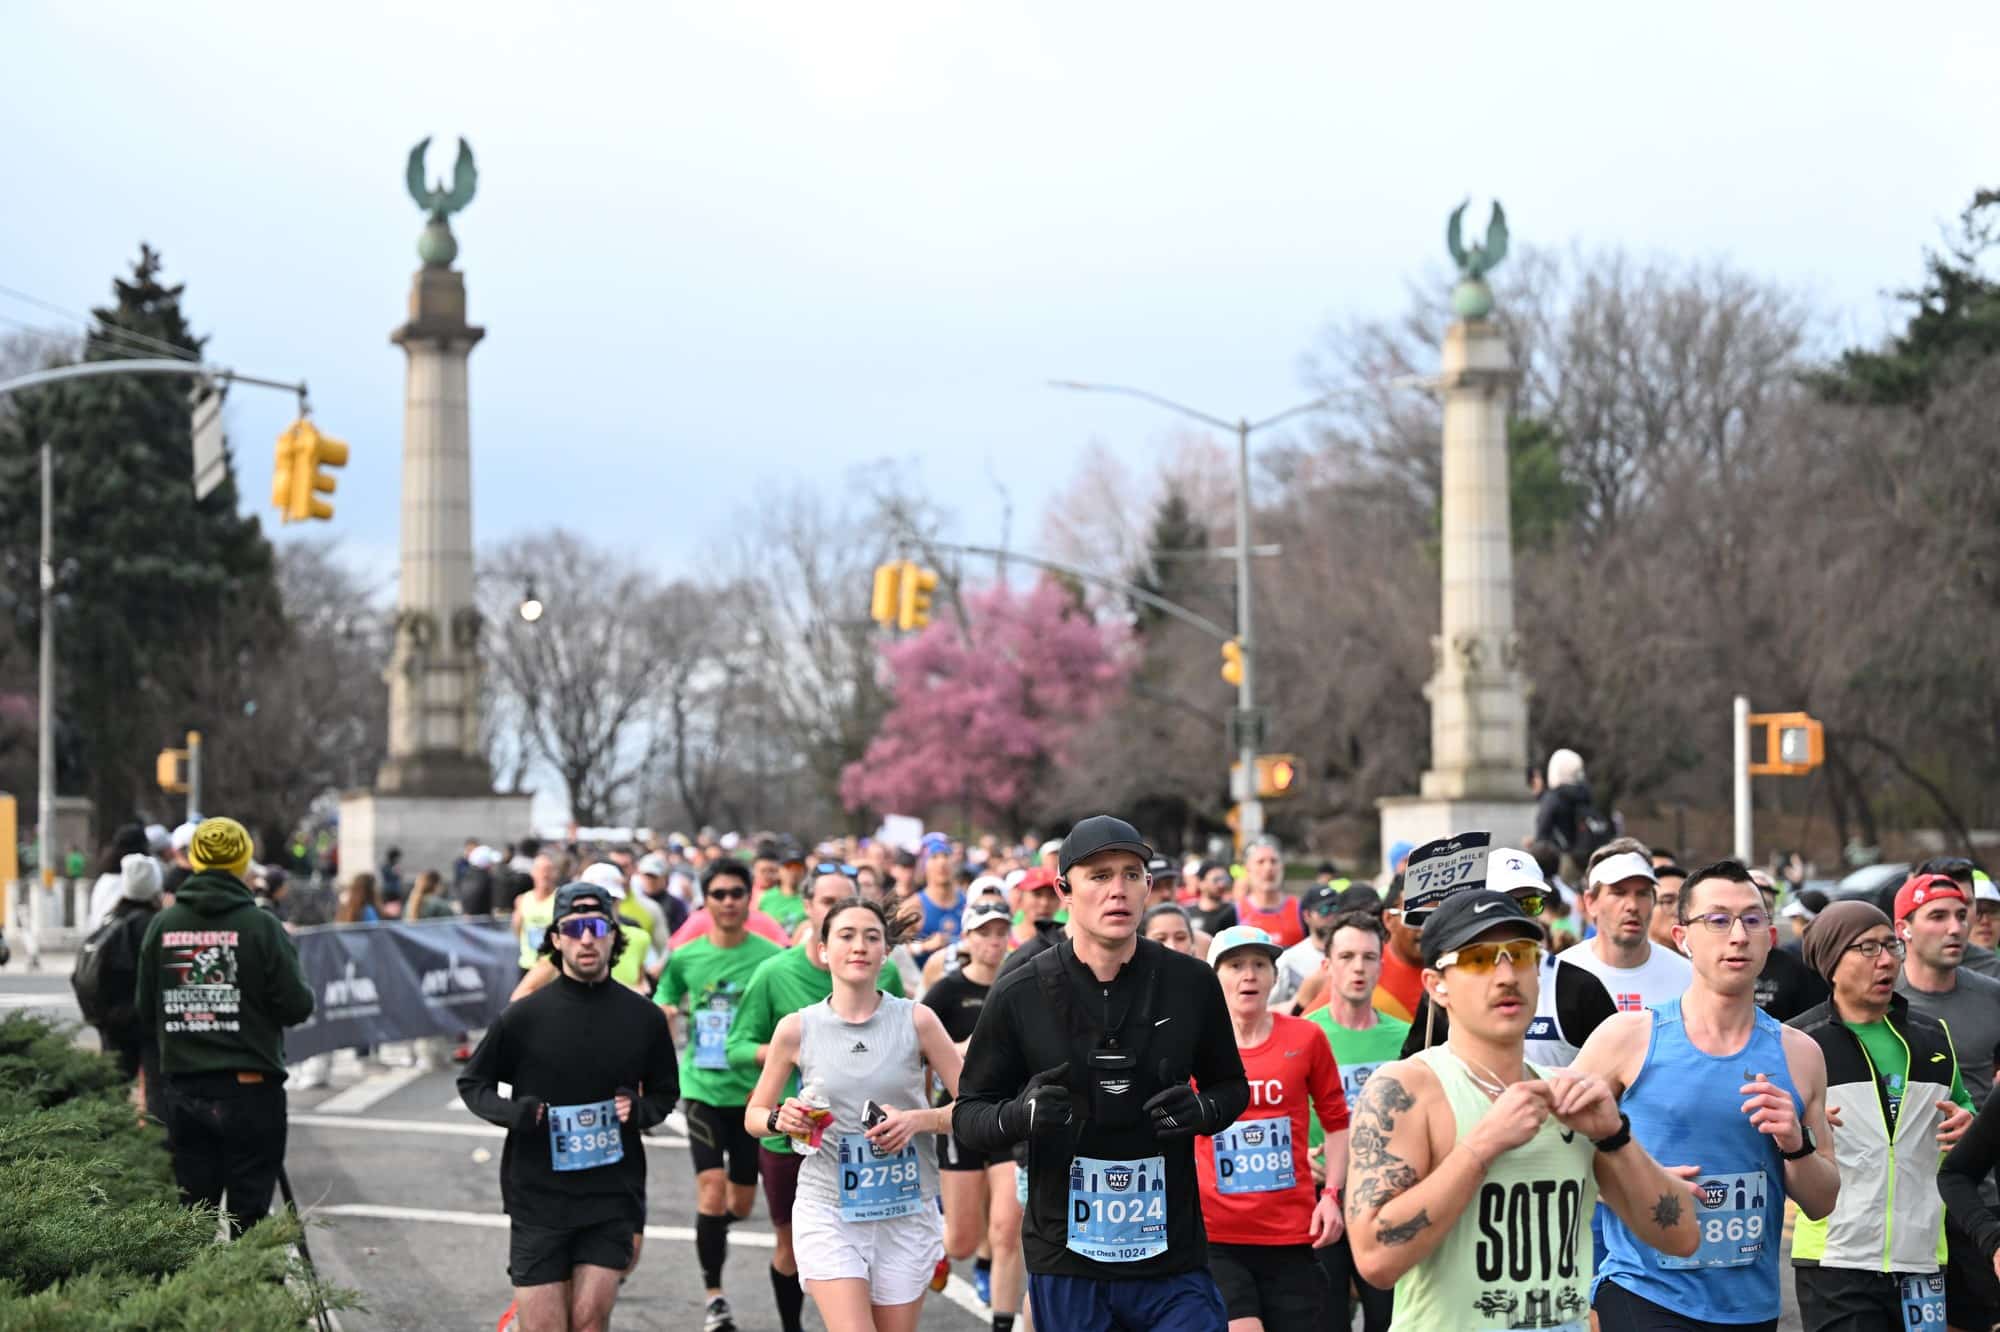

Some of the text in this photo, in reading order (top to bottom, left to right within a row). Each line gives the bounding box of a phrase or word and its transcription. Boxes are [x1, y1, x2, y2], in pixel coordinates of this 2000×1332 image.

[1409, 852, 1485, 877] PACE PER MILE
[1417, 861, 1474, 890] 7:37
[1526, 1022, 1549, 1035] NB
[556, 1128, 619, 1153] E3363
[1220, 1150, 1291, 1177] D3089
[844, 1162, 917, 1191] D2758
[1109, 1173, 1128, 1181] NYC
[885, 1205, 907, 1216] 2758
[1074, 1196, 1164, 1223] D1024
[1697, 1215, 1763, 1243] 869
[1096, 1249, 1116, 1257] Check
[1118, 1247, 1146, 1258] 1024
